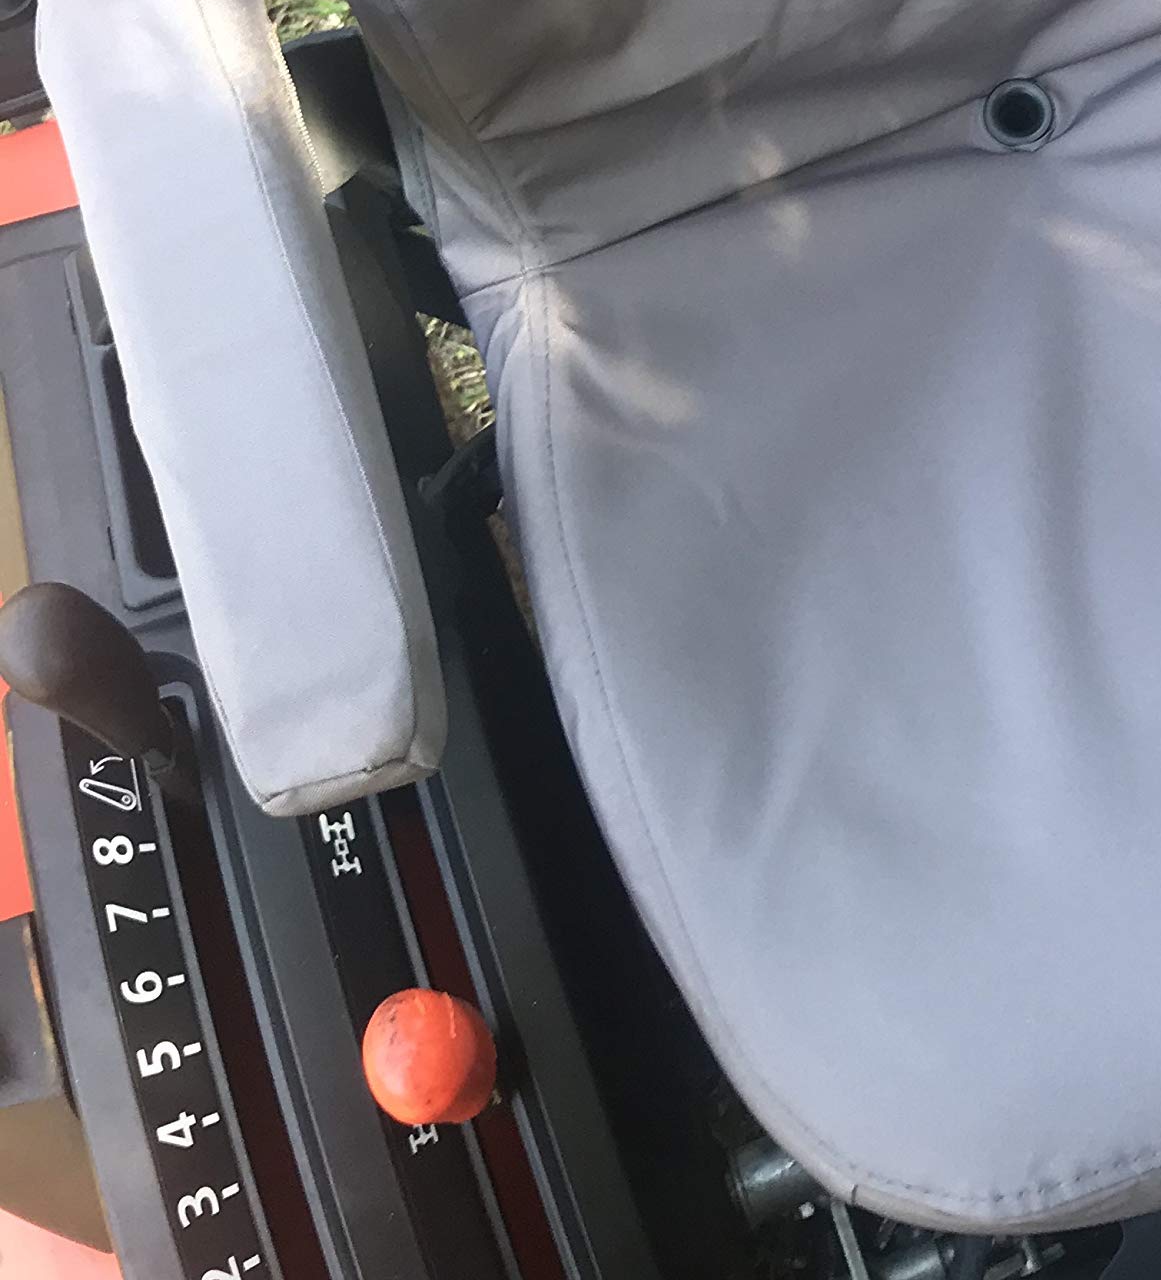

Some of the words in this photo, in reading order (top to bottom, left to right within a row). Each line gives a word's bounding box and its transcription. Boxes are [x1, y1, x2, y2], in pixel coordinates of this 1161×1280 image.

[92, 835, 133, 866] 8
[105, 903, 148, 932] 7
[121, 971, 162, 1003] 6
[136, 1041, 181, 1077] 5
[156, 1111, 196, 1148] 4
[177, 1186, 220, 1228] 3
